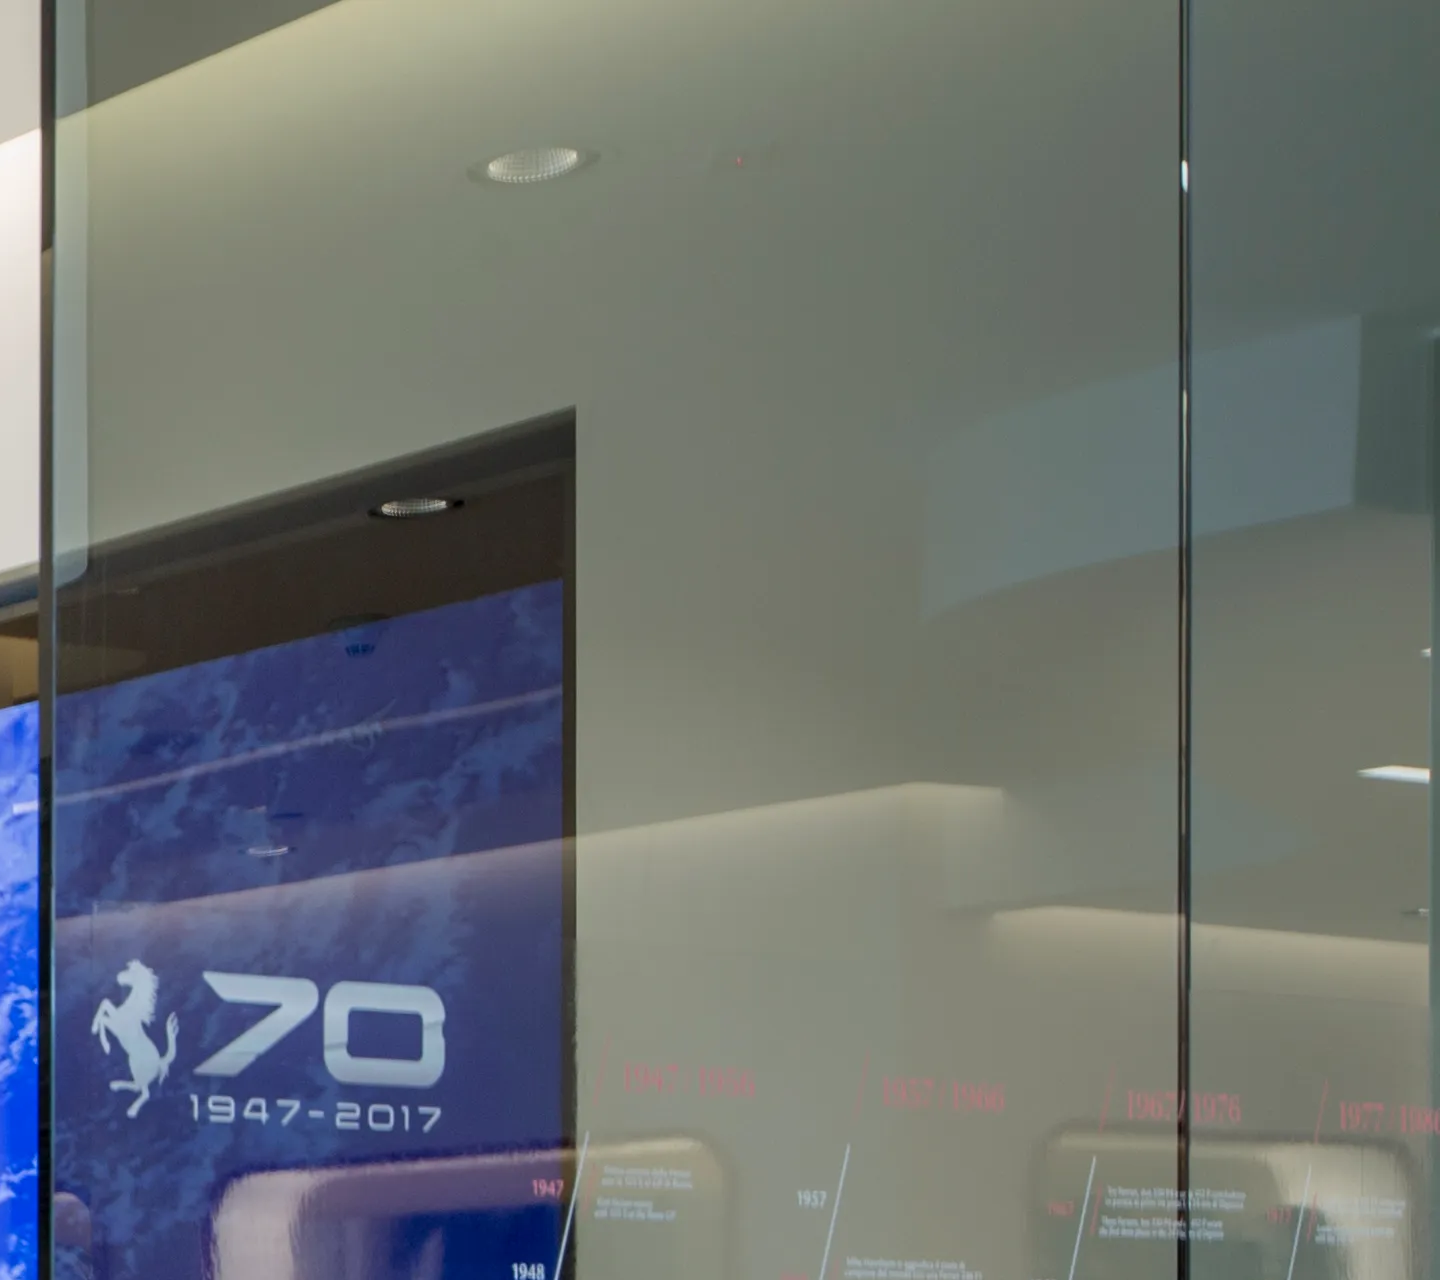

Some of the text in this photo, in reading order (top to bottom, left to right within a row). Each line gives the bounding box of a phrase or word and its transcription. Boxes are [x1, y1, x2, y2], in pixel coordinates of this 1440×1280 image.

[193, 971, 446, 1089] 70
[189, 1094, 442, 1133] 1947-2017
[532, 1178, 565, 1198] 1947
[797, 1190, 826, 1209] 1957
